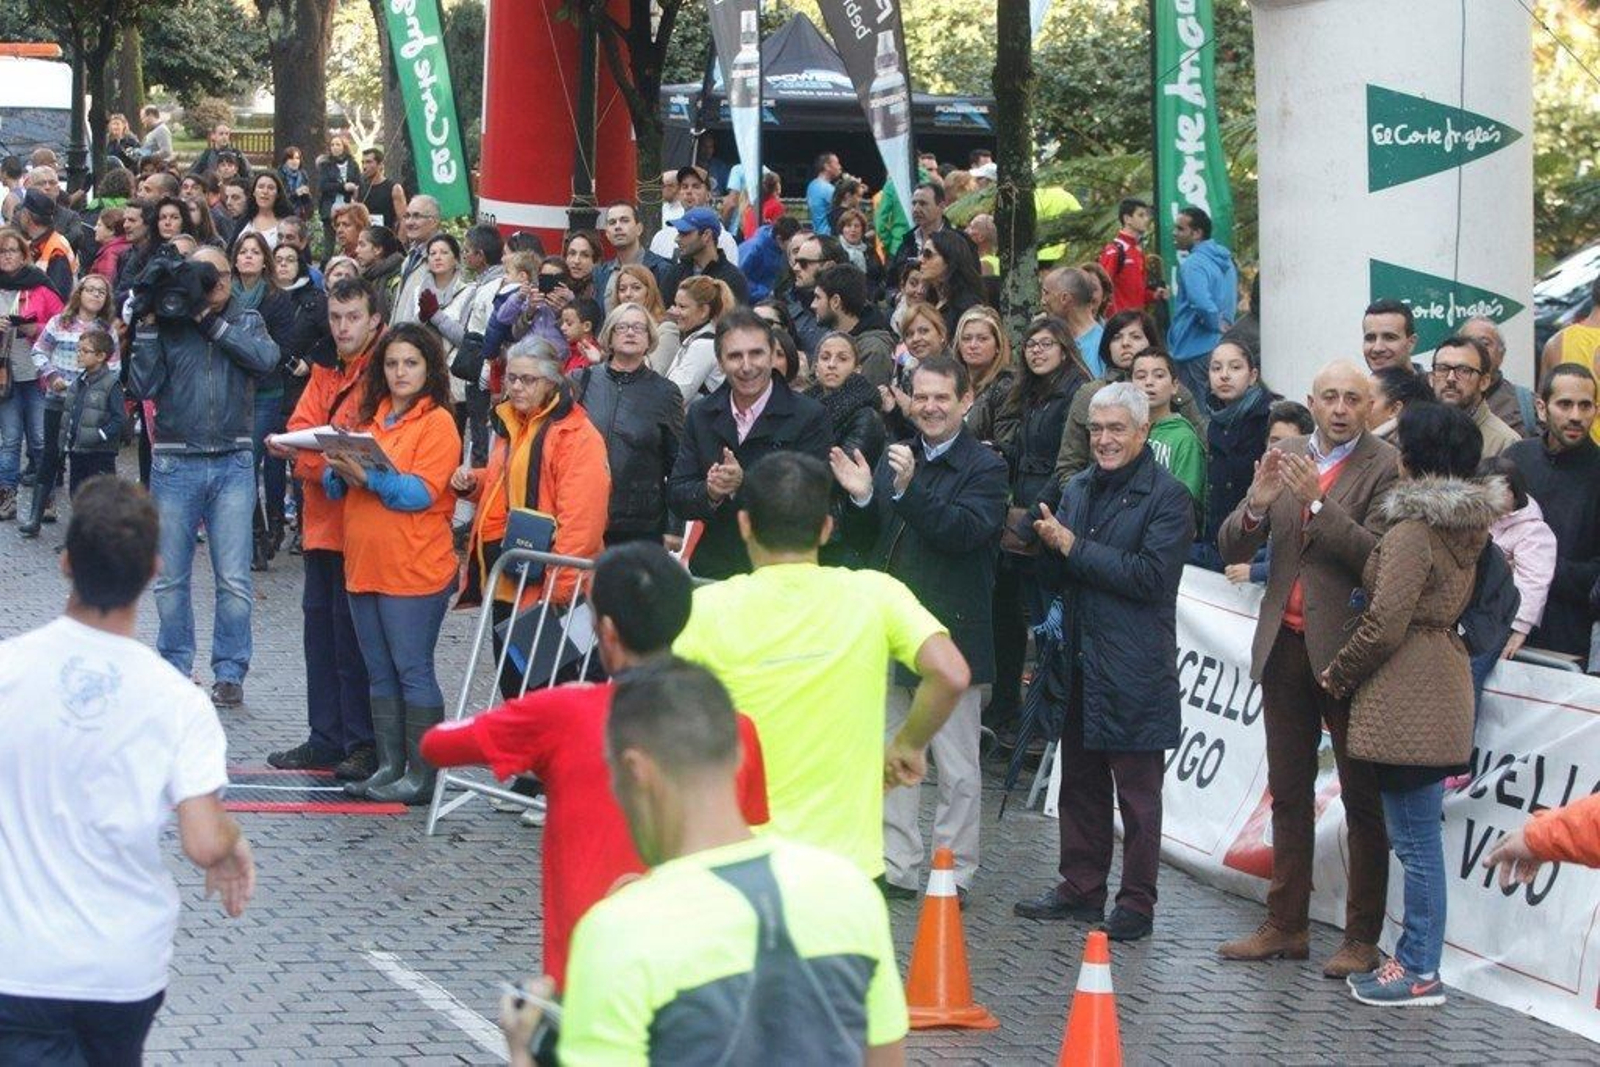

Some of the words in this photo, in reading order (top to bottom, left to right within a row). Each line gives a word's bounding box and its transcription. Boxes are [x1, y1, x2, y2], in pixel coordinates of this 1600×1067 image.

[1372, 123, 1393, 145] El
[1394, 124, 1442, 145] Corte
[1443, 117, 1502, 153] Inglés
[1402, 299, 1445, 320] orte
[1176, 648, 1264, 727] CELLO
[1460, 817, 1561, 907] VIO
